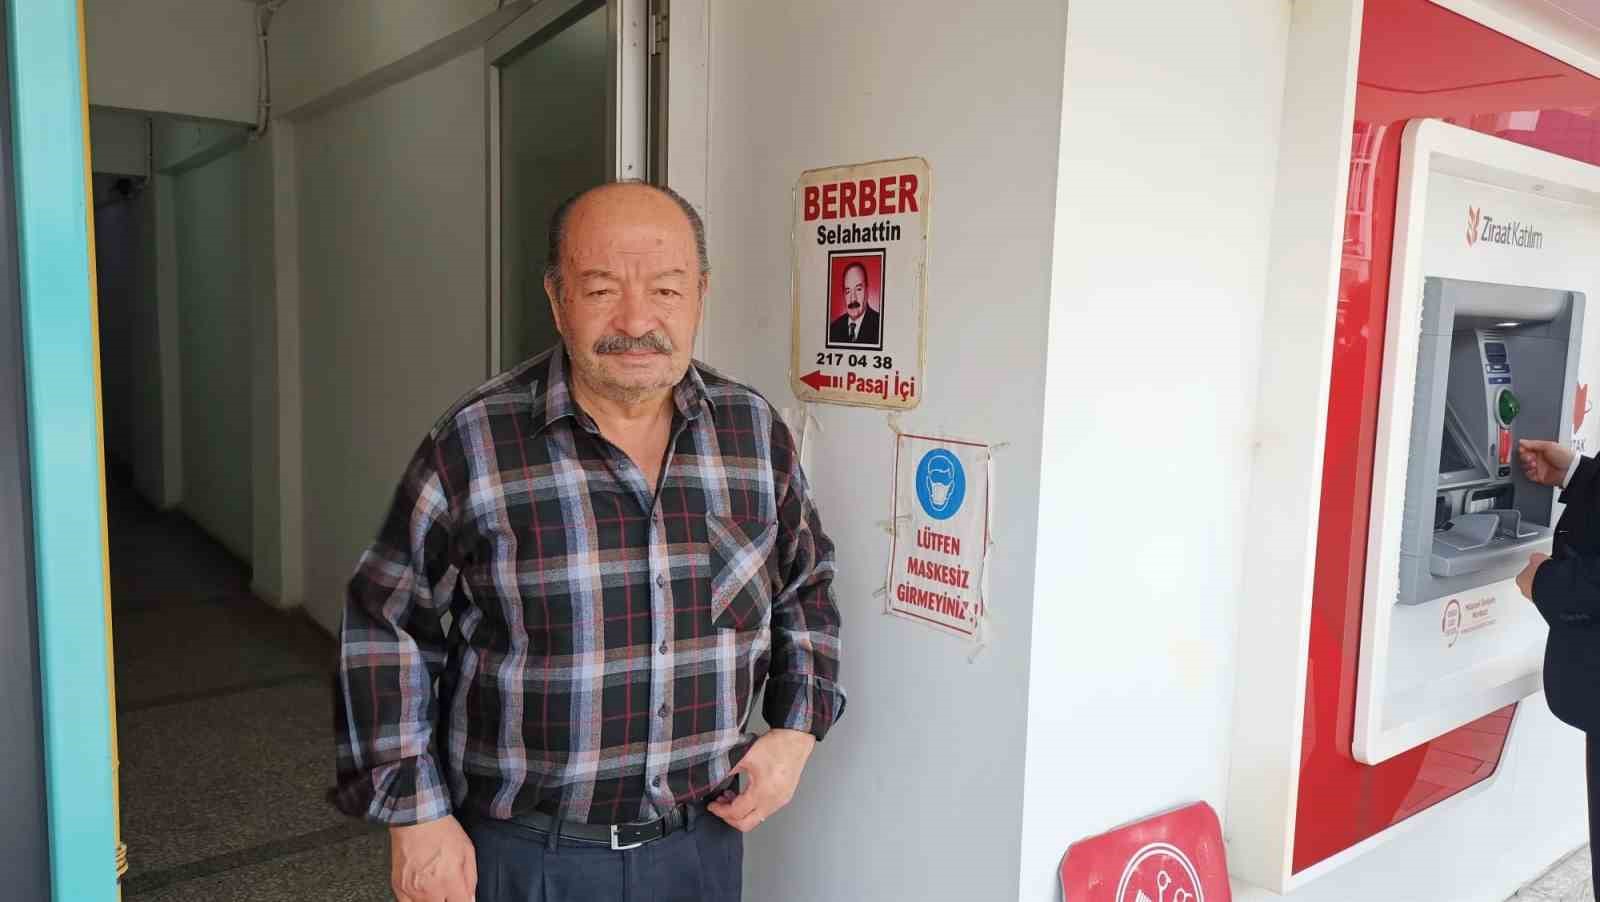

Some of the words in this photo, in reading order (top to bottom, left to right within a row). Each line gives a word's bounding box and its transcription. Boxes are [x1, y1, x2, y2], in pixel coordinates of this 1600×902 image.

[804, 174, 919, 221] BERBER
[817, 220, 901, 244] Selahattin
[1481, 215, 1511, 244] Ziraat
[816, 353, 843, 366] 217
[848, 354, 867, 368] 04
[872, 356, 893, 369] 38
[846, 371, 889, 400] Pasaj
[894, 371, 915, 402] İçi
[917, 526, 960, 556] LÜTFEN
[907, 556, 969, 589] MASKESİZ
